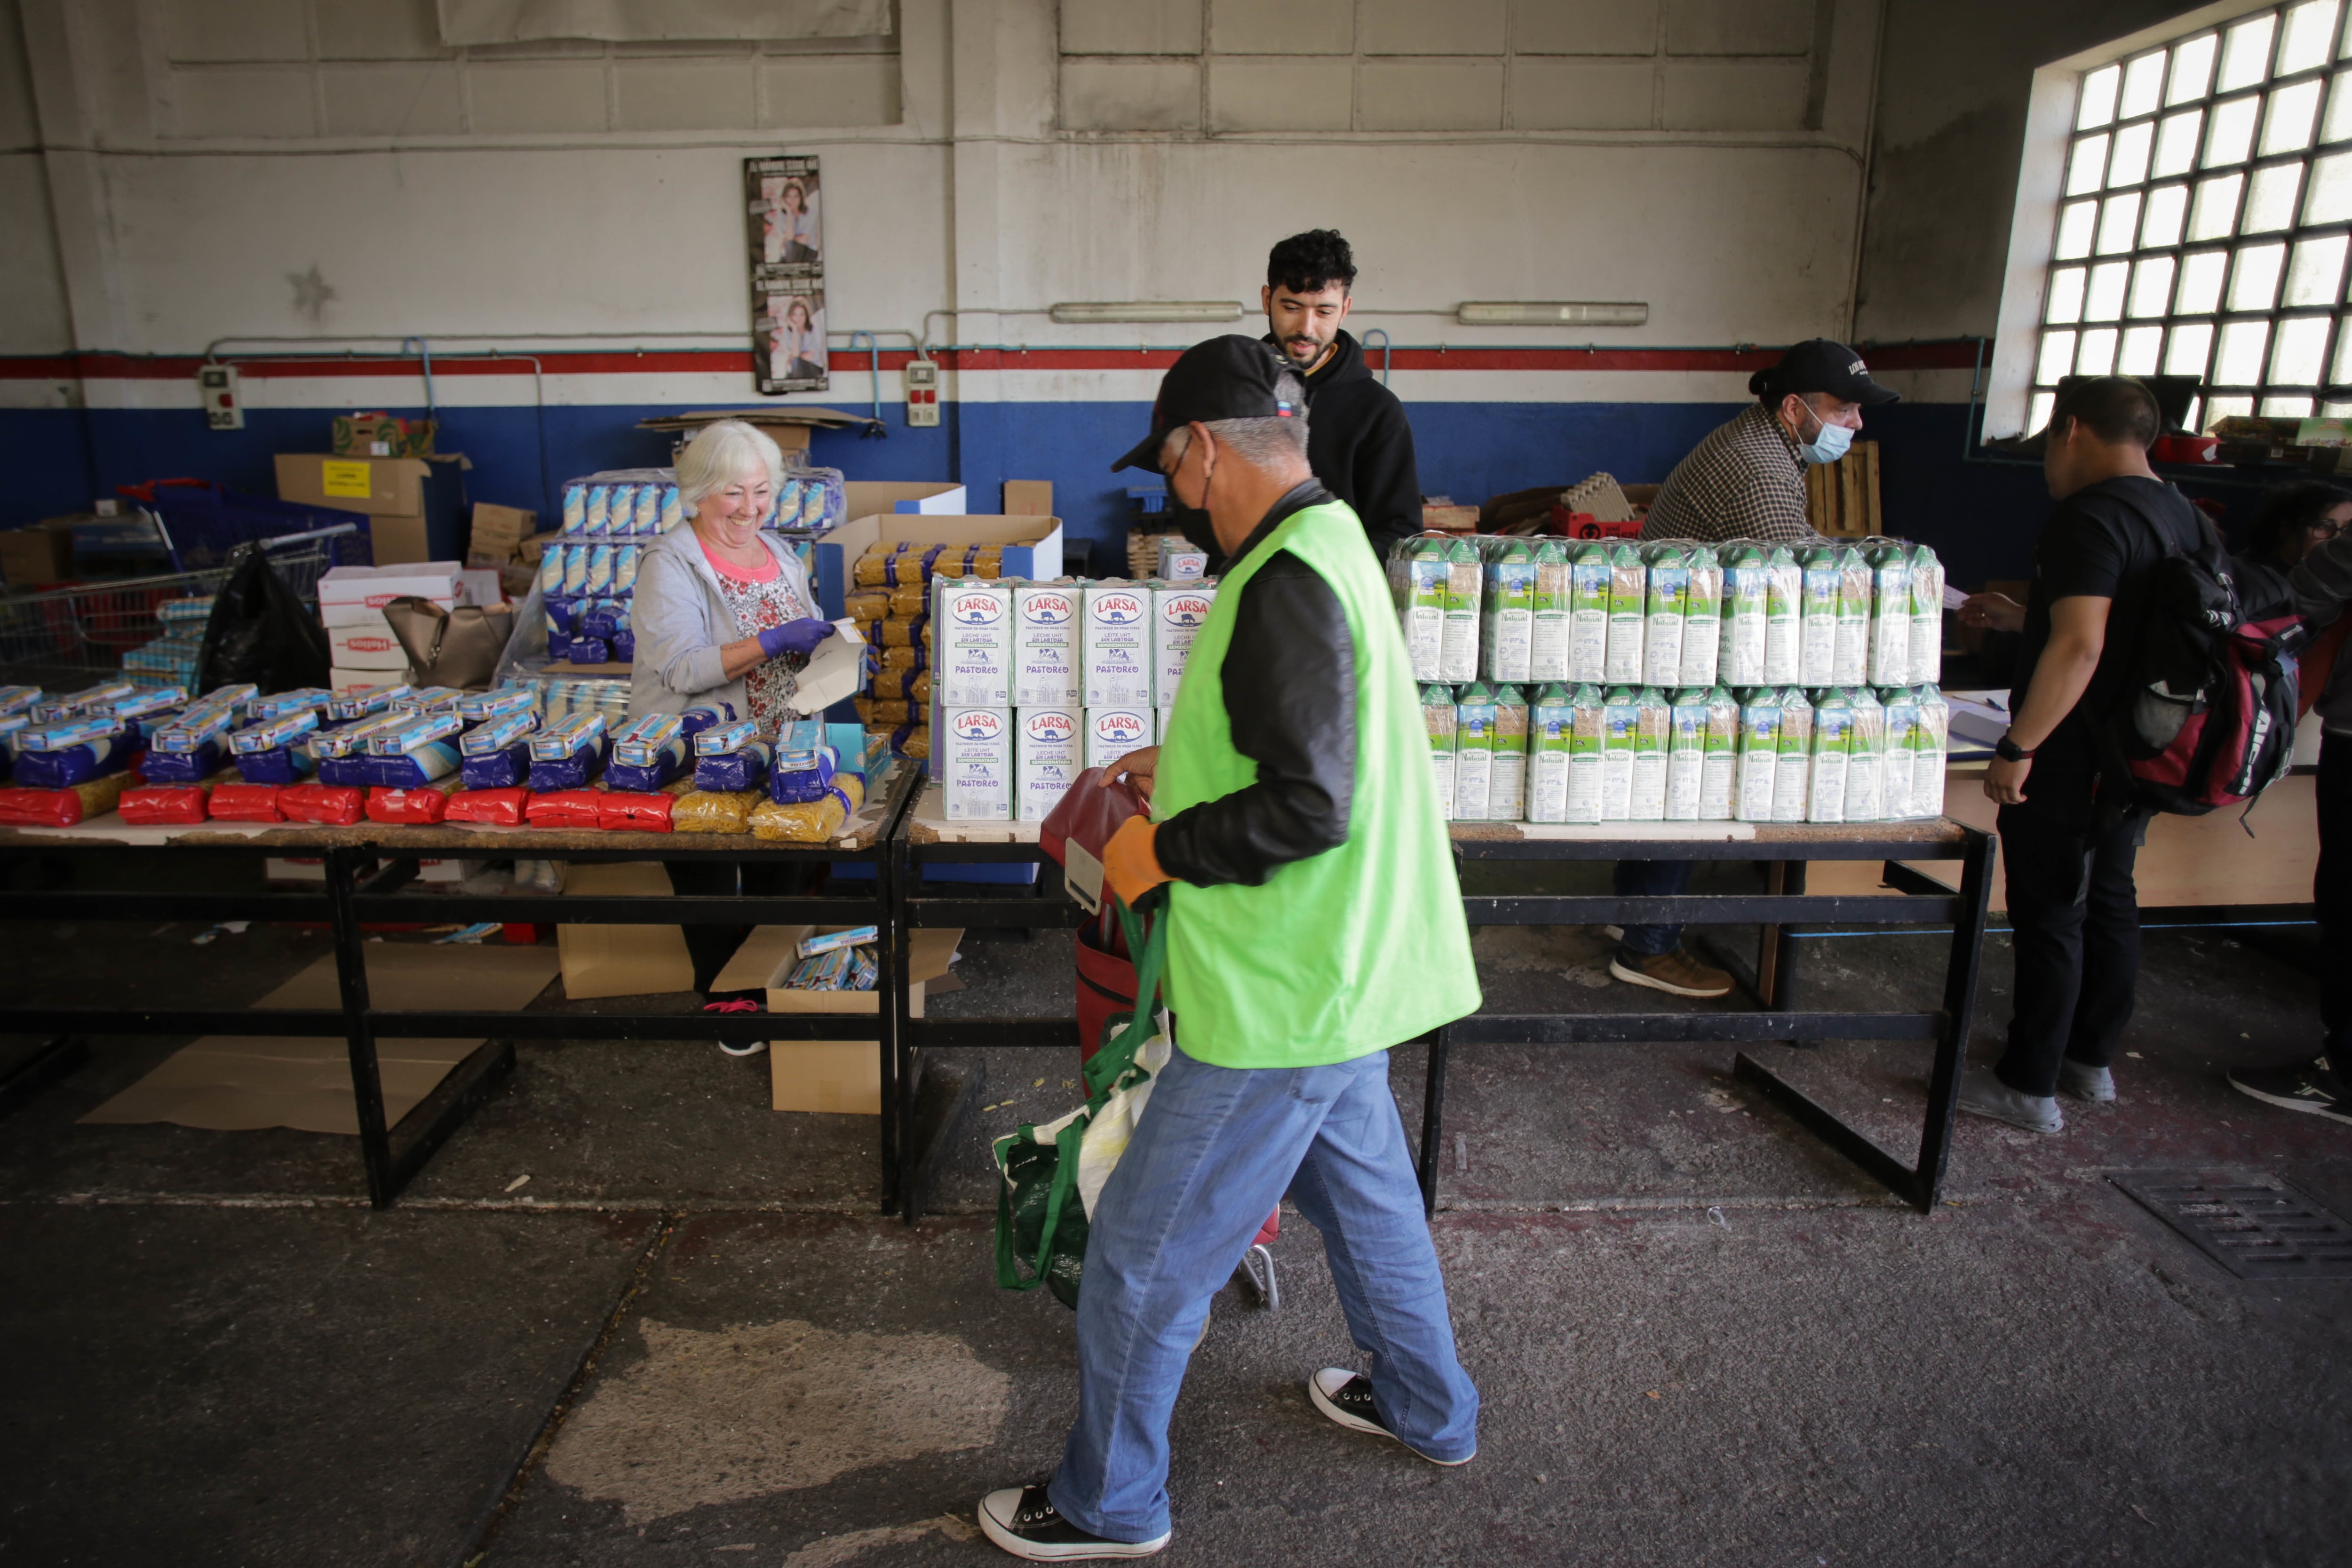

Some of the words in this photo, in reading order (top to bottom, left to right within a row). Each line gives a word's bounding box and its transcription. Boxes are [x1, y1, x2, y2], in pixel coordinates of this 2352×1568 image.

[1178, 559, 1200, 568] LARSA
[957, 598, 997, 613] LARSA
[1028, 598, 1068, 613] LARSA
[1098, 598, 1137, 613] LARSA
[1169, 600, 1208, 615] LARSA
[1502, 612, 1528, 621] Natural
[350, 640, 388, 649] Helios
[958, 715, 997, 730] LARSA
[1032, 716, 1072, 732] LARSA
[1101, 717, 1140, 732] LARSA
[1539, 756, 1564, 764] Natural
[1605, 754, 1629, 762] Natural
